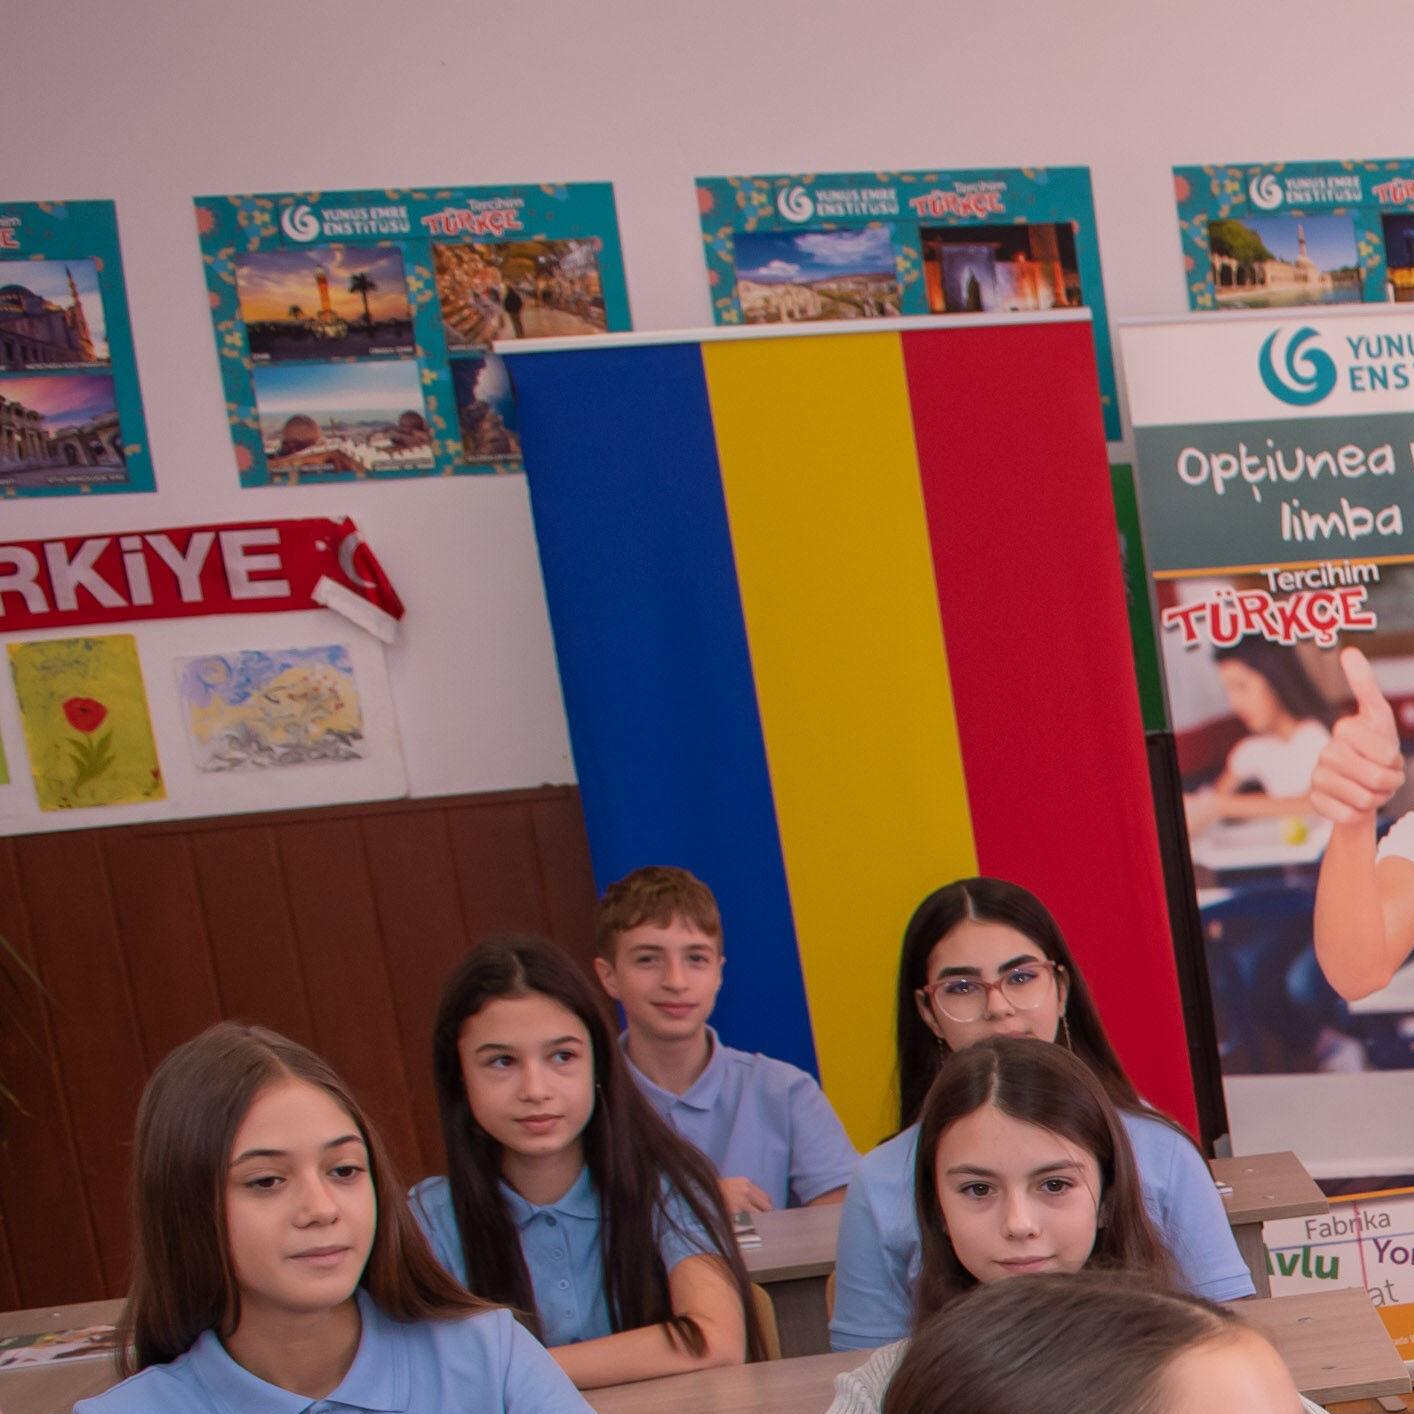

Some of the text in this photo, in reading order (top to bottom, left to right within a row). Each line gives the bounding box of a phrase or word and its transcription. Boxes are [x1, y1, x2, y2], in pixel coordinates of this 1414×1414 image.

[321, 206, 407, 220] YUNUS EMRE
[420, 207, 525, 237] TÜRKÇE
[1281, 499, 1403, 542] limba
[1260, 561, 1381, 595] Tercihim
[1161, 586, 1379, 649] TÜRKÇE
[1304, 1210, 1391, 1241] Fabrika
